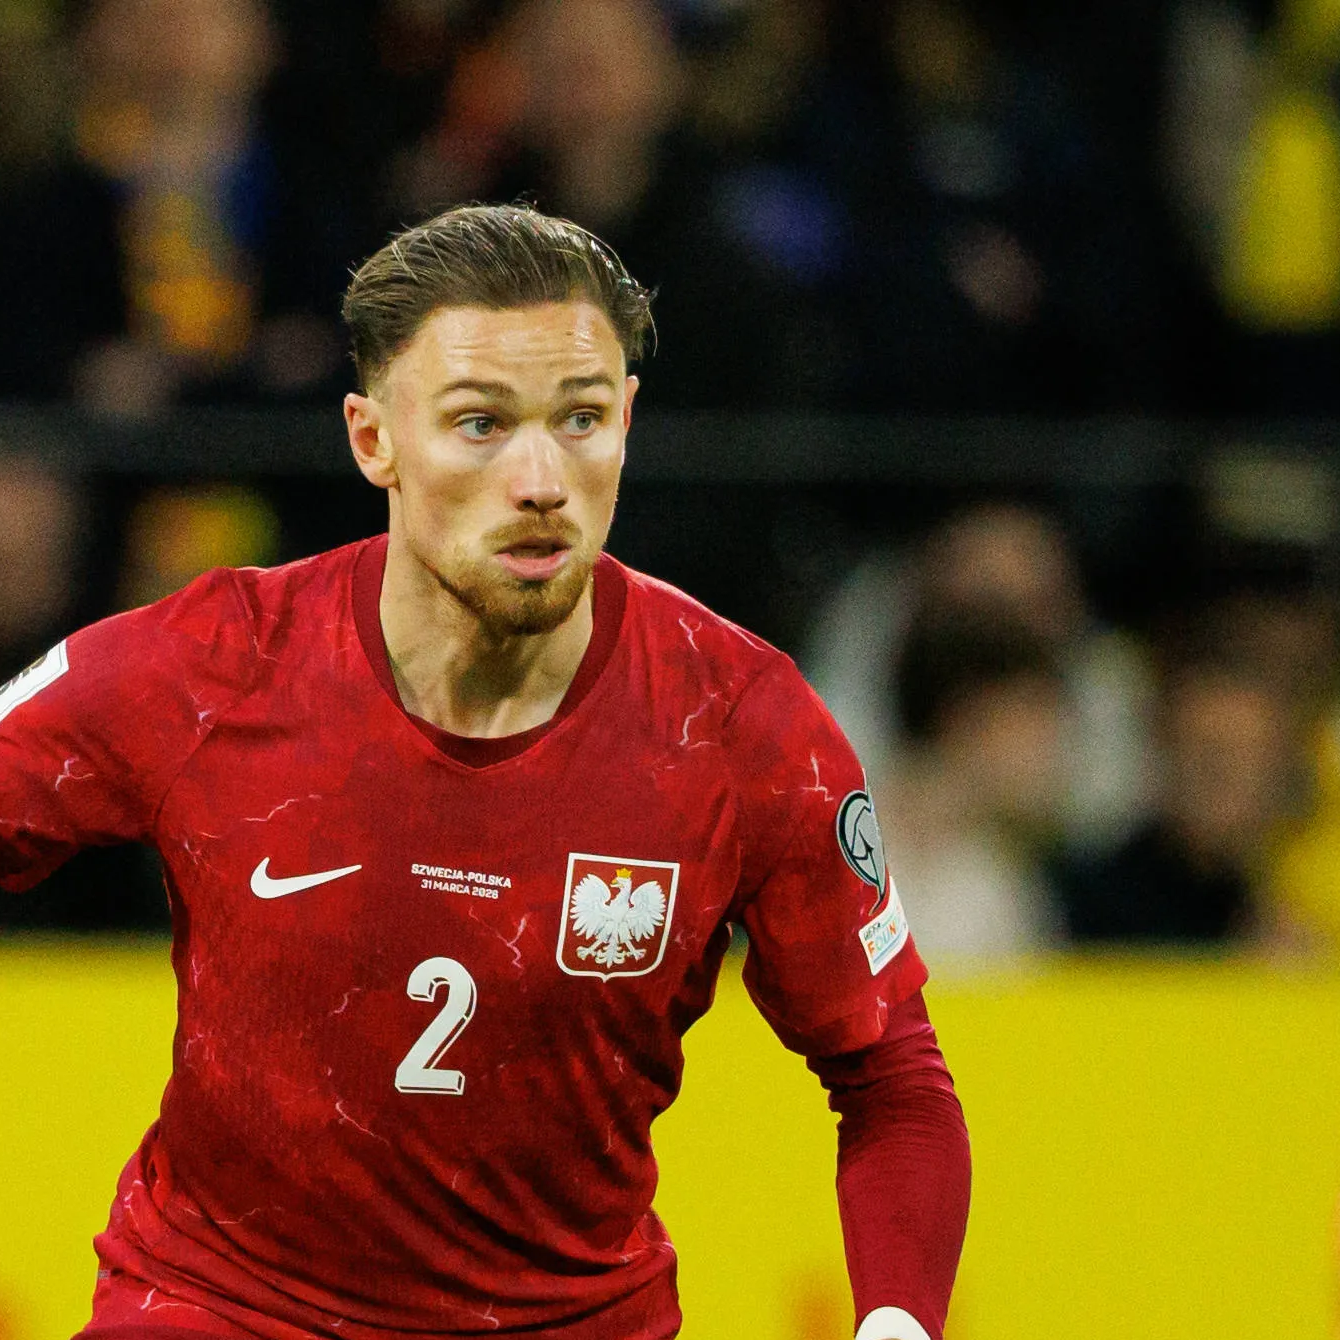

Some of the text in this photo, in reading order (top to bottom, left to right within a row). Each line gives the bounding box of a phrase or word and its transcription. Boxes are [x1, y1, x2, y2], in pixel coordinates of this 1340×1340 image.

[411, 863, 512, 888] SZWECJA-POLSKA
[421, 879, 432, 890] 31
[433, 881, 471, 895] MARCA
[394, 956, 478, 1096] 2
